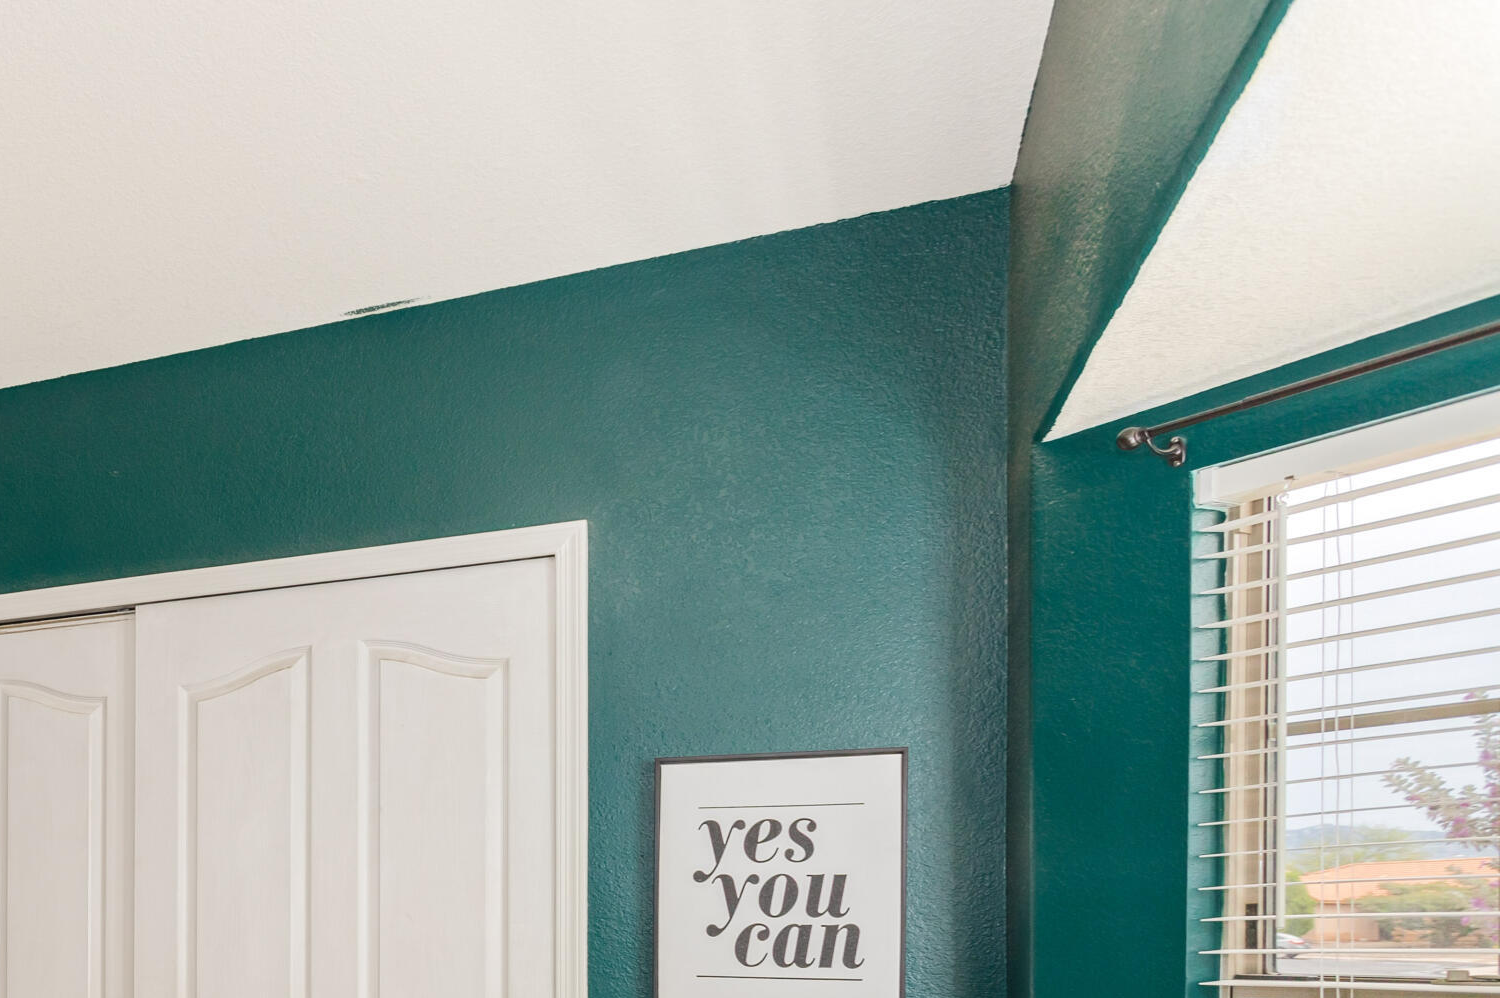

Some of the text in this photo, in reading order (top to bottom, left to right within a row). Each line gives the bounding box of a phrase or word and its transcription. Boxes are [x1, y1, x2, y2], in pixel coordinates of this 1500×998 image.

[693, 818, 817, 883] yes
[706, 873, 850, 937] you
[734, 923, 865, 969] can
